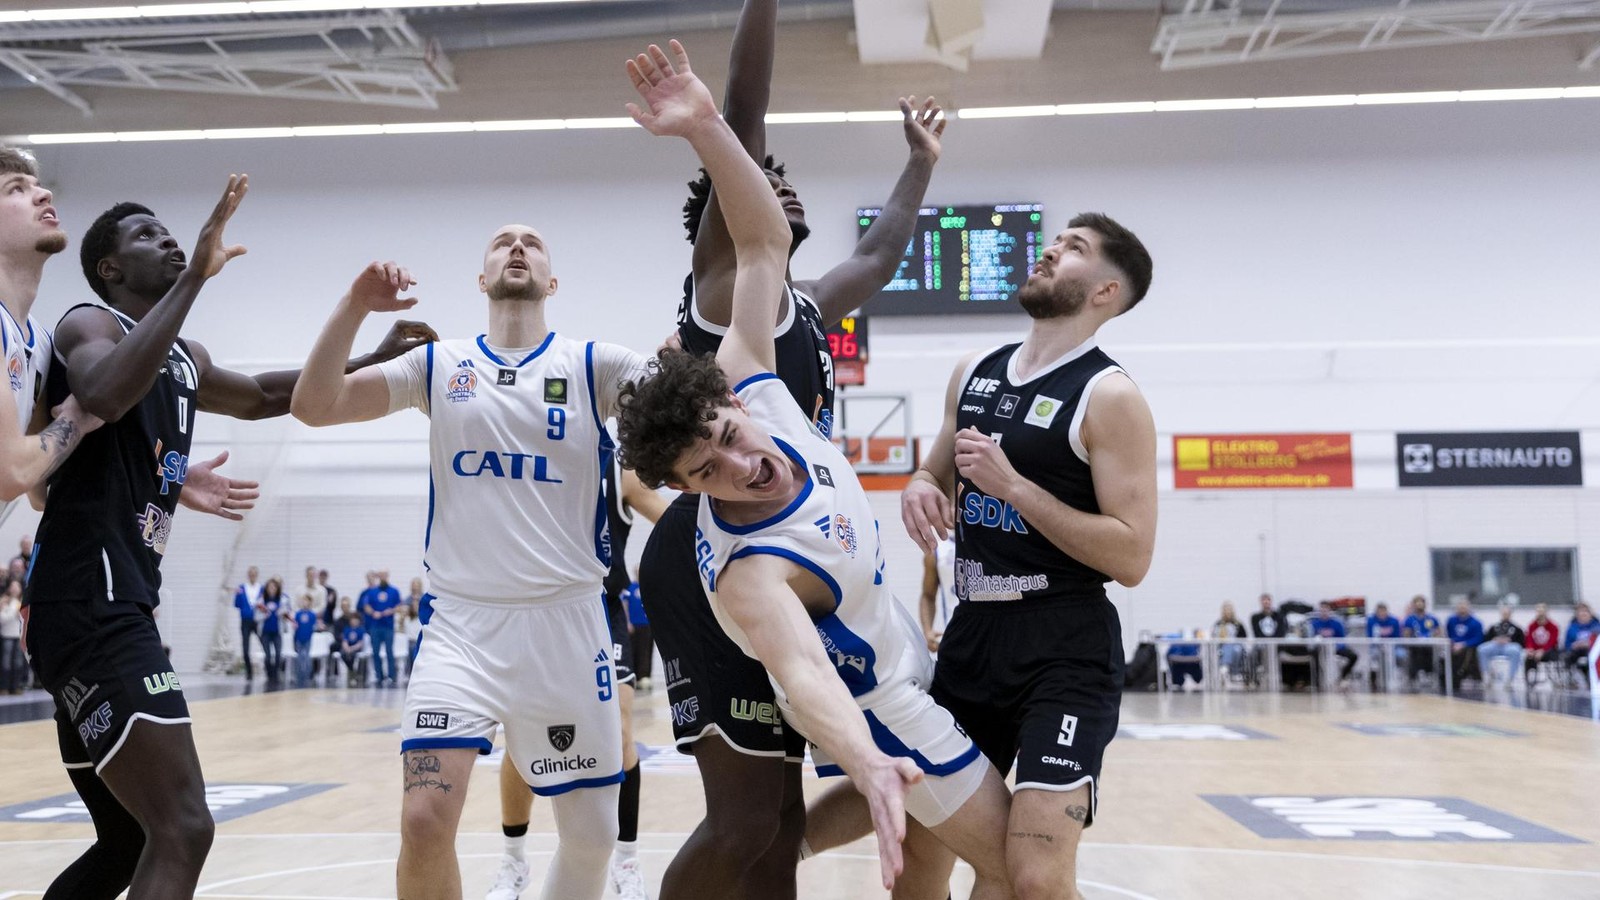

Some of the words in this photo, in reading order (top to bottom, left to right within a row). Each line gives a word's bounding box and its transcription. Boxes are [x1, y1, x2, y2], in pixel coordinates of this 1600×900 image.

[547, 407, 566, 441] 9
[1212, 440, 1279, 454] ELEKTRO
[1436, 447, 1573, 468] STERNAUTO
[453, 450, 563, 484] CATL
[1213, 454, 1297, 468] STOLLBERG
[964, 492, 1029, 535] SDK
[596, 664, 613, 702] 9
[418, 713, 446, 728] SWE
[1057, 713, 1079, 747] 9
[530, 754, 597, 775] Glinicke
[1041, 755, 1075, 769] CRAFT
